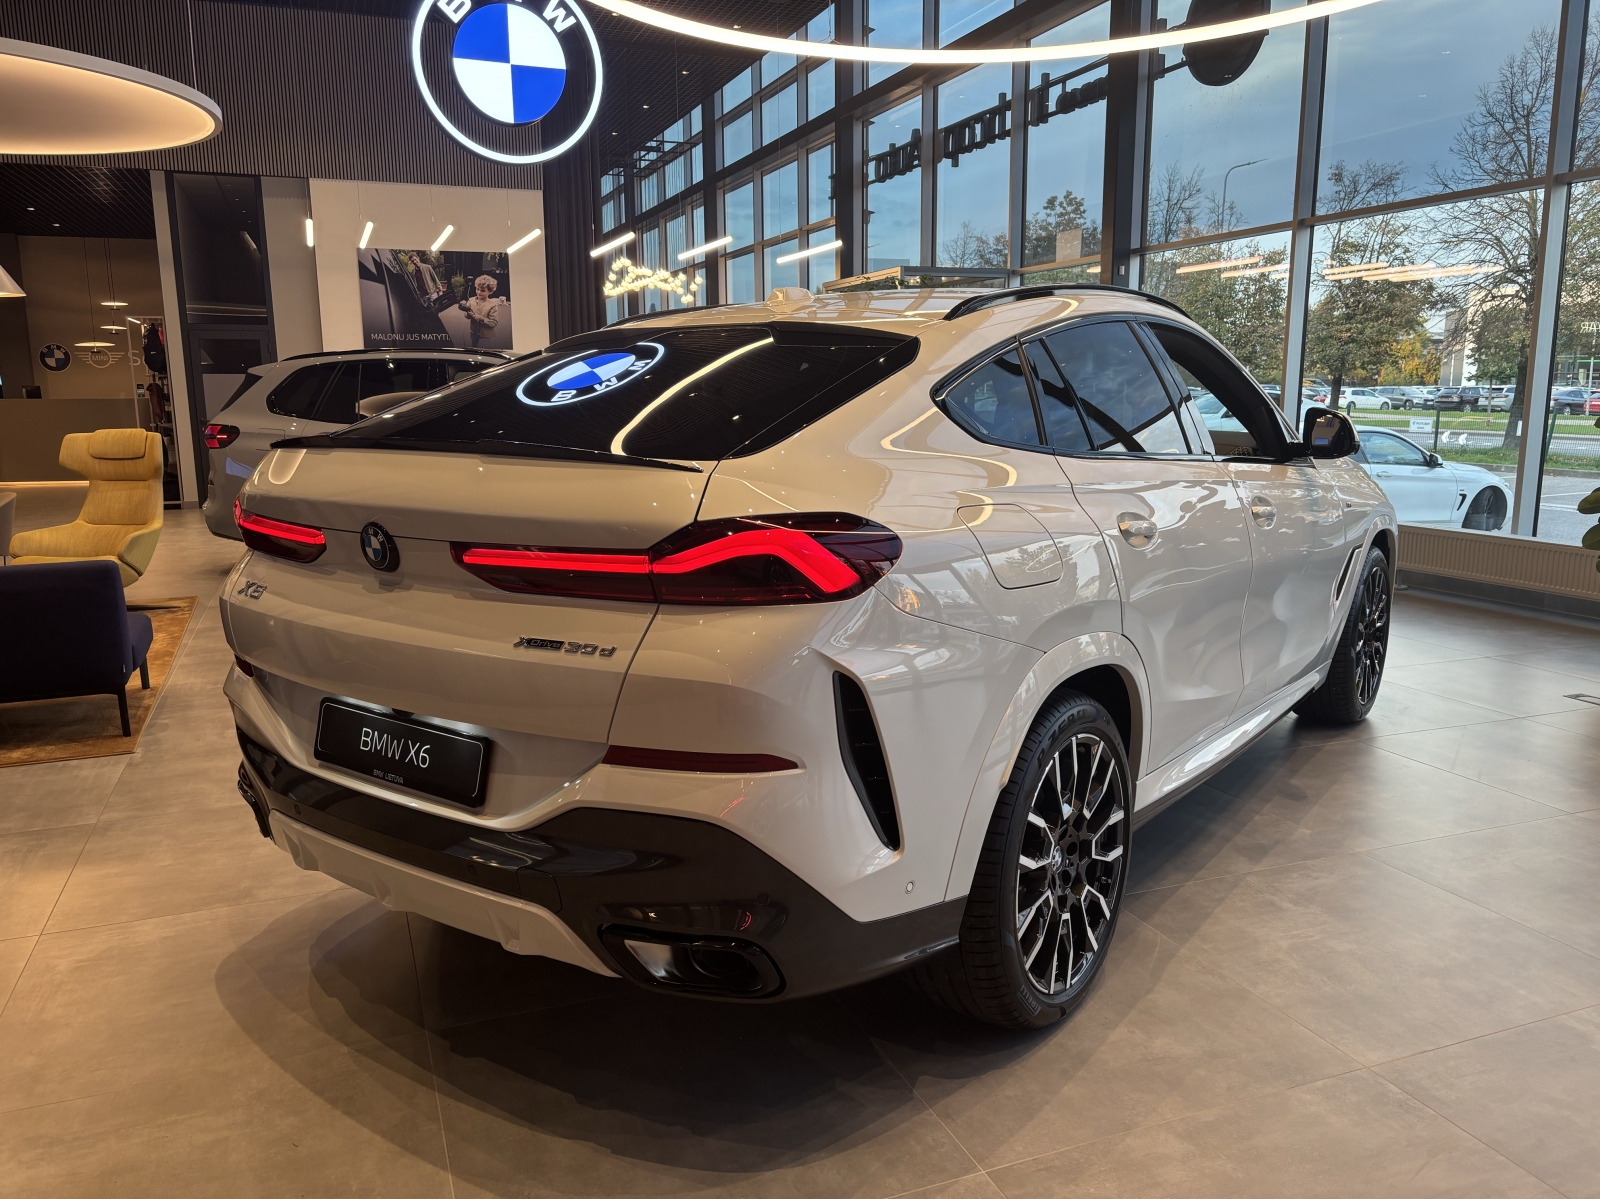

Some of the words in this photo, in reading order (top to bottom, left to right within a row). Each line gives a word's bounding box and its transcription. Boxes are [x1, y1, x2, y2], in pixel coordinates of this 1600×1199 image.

[437, 0, 577, 33] BW
[42, 344, 66, 353] BMW
[237, 580, 267, 600] X6
[360, 727, 405, 760] BMW
[405, 739, 431, 768] X6
